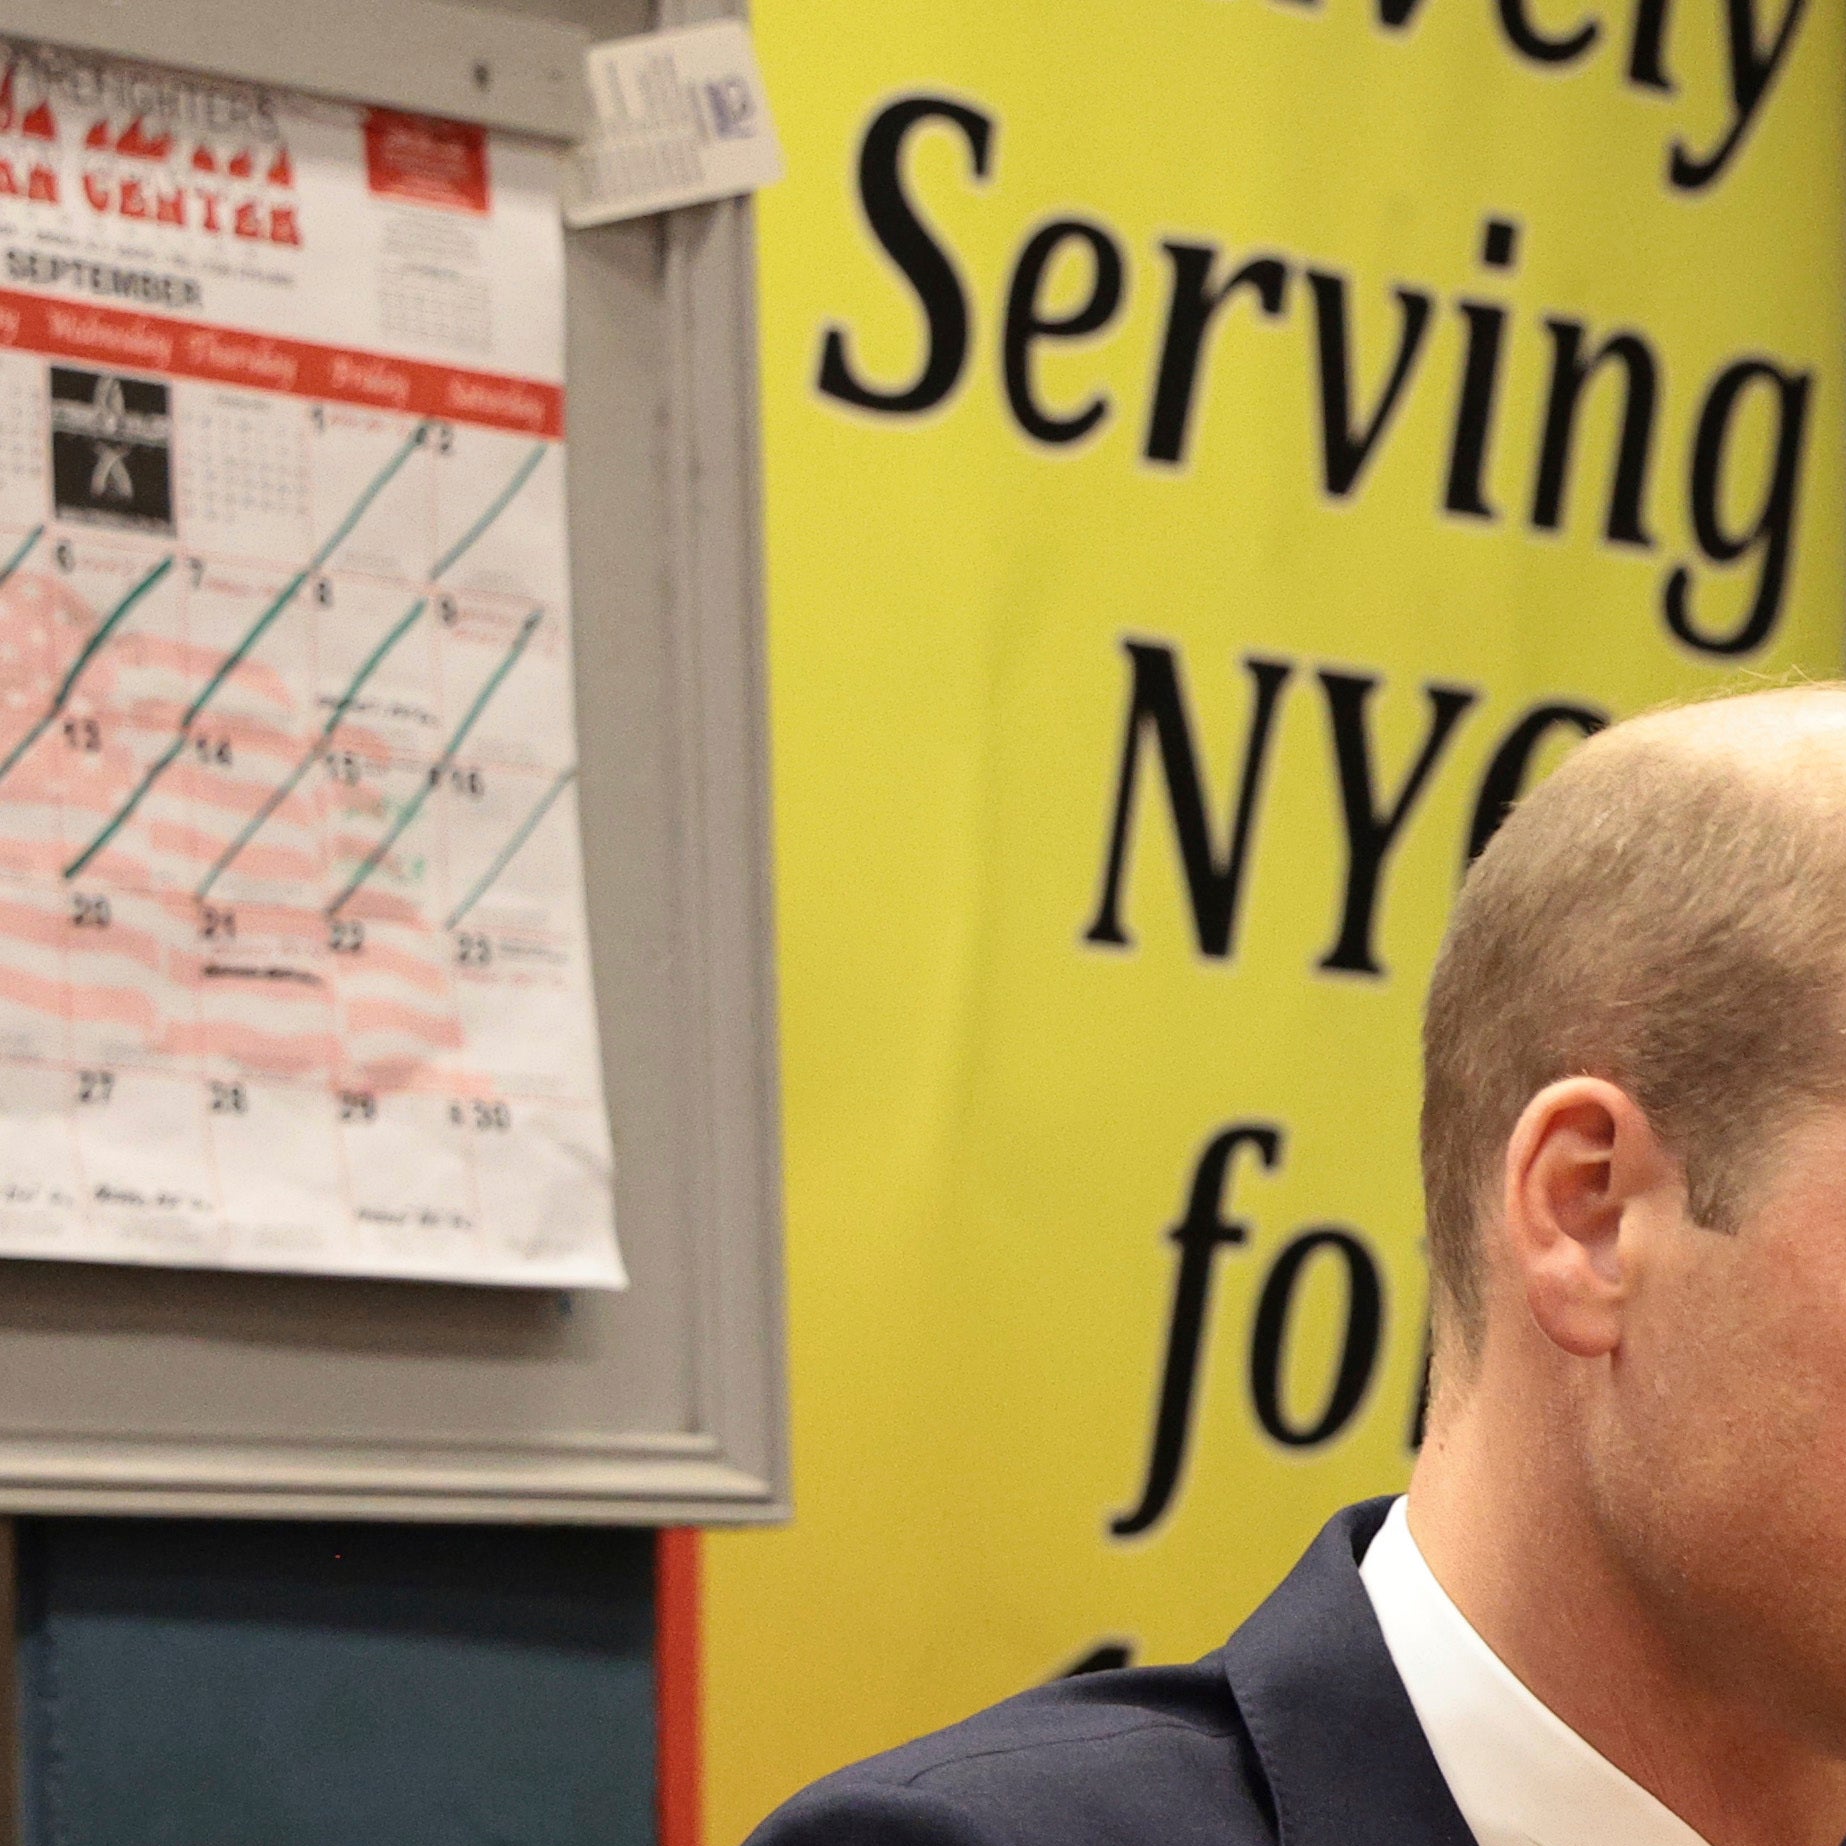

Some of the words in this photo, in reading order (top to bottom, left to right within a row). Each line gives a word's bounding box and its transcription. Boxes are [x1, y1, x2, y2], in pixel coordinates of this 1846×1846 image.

[6, 249, 203, 309] SEPTEMBER
[817, 95, 1815, 657] Serving
[1107, 1122, 1428, 1538] fo
